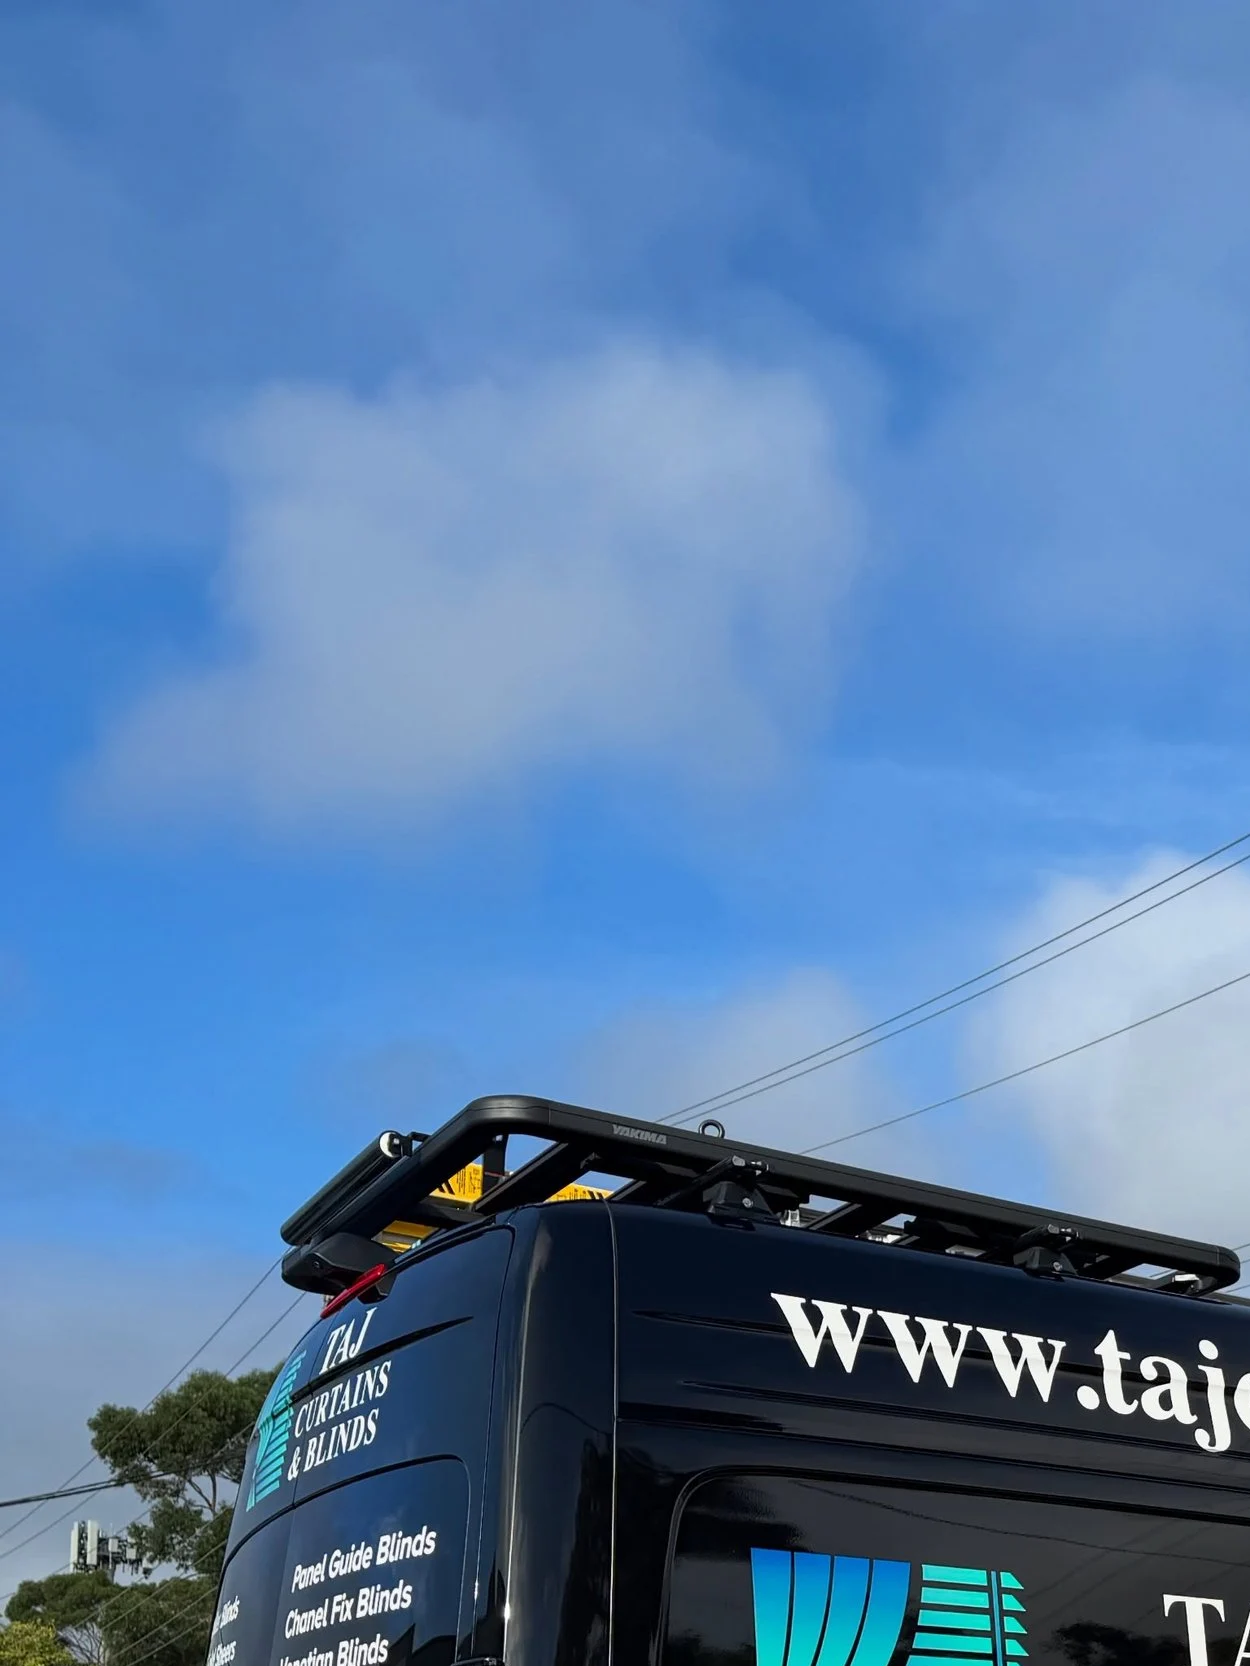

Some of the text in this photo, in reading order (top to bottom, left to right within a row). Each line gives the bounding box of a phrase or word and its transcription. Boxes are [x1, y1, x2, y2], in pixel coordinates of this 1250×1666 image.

[612, 1124, 667, 1145] YAKIMA
[319, 1307, 378, 1375] TAJ
[294, 1360, 392, 1438] CURTAINS
[287, 1408, 380, 1481] & BLINDS
[291, 1525, 437, 1593] Panel Guide Blinds
[285, 1579, 413, 1639] Chanel Fix Blinds
